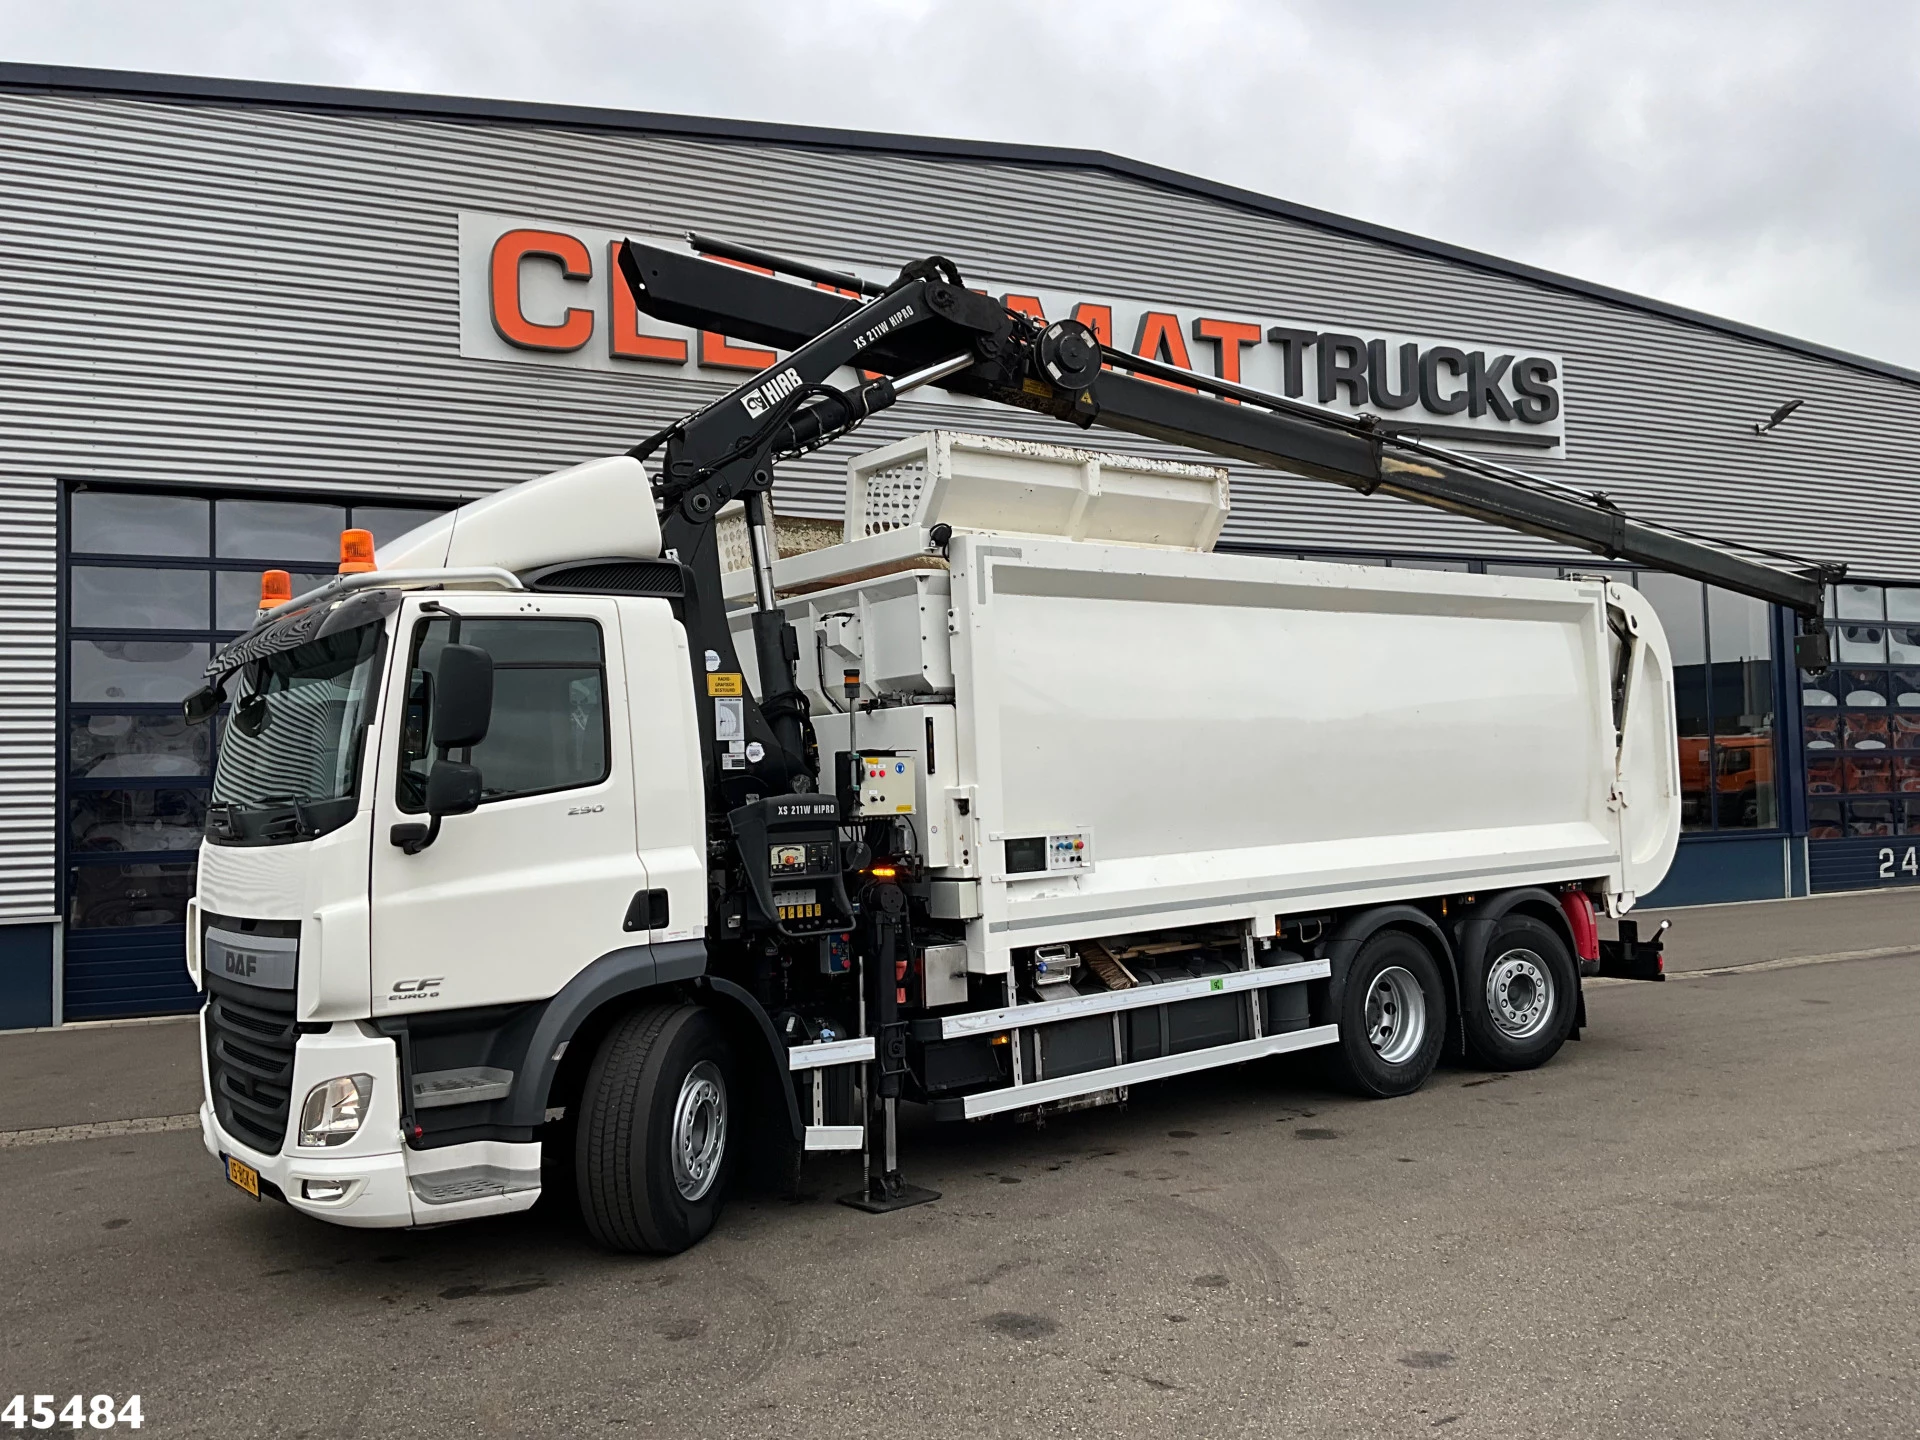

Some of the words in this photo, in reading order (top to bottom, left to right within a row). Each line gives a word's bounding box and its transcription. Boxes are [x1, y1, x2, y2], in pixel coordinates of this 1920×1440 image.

[488, 228, 1262, 406] CLAT
[1267, 326, 1560, 424] TRUCKS
[853, 335, 866, 350] XS
[866, 321, 890, 343] 211W
[888, 305, 914, 327] HIPRO
[761, 367, 803, 405] HIAB
[777, 805, 788, 815] XS
[791, 805, 811, 815] 211W
[813, 804, 835, 814] HIPRO
[1878, 846, 1919, 878] 24
[225, 951, 257, 977] DAF
[389, 993, 428, 1001] EURO
[392, 976, 445, 993] CF
